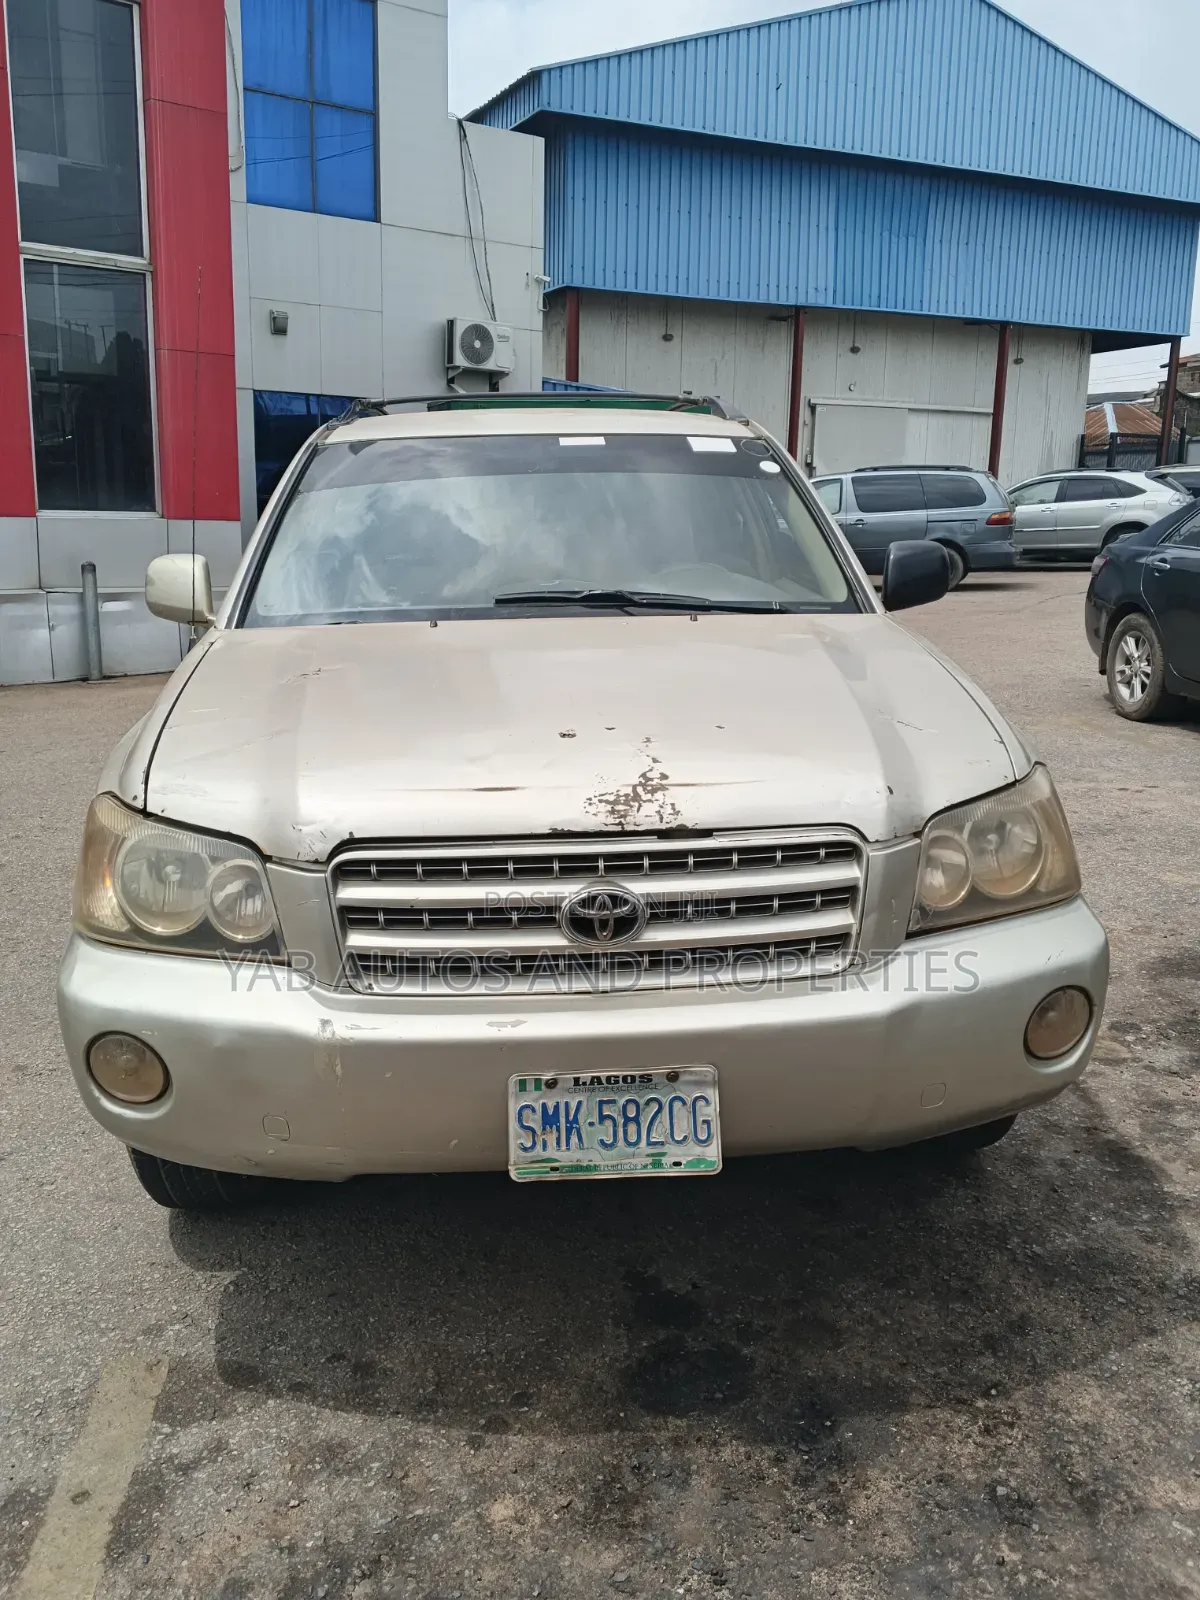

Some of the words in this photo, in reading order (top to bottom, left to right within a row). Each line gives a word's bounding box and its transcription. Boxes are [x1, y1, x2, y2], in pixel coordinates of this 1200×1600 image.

[572, 1073, 653, 1087] LAGOS
[567, 1086, 597, 1094] CENTRE
[611, 1083, 659, 1092] EXCELLENCE
